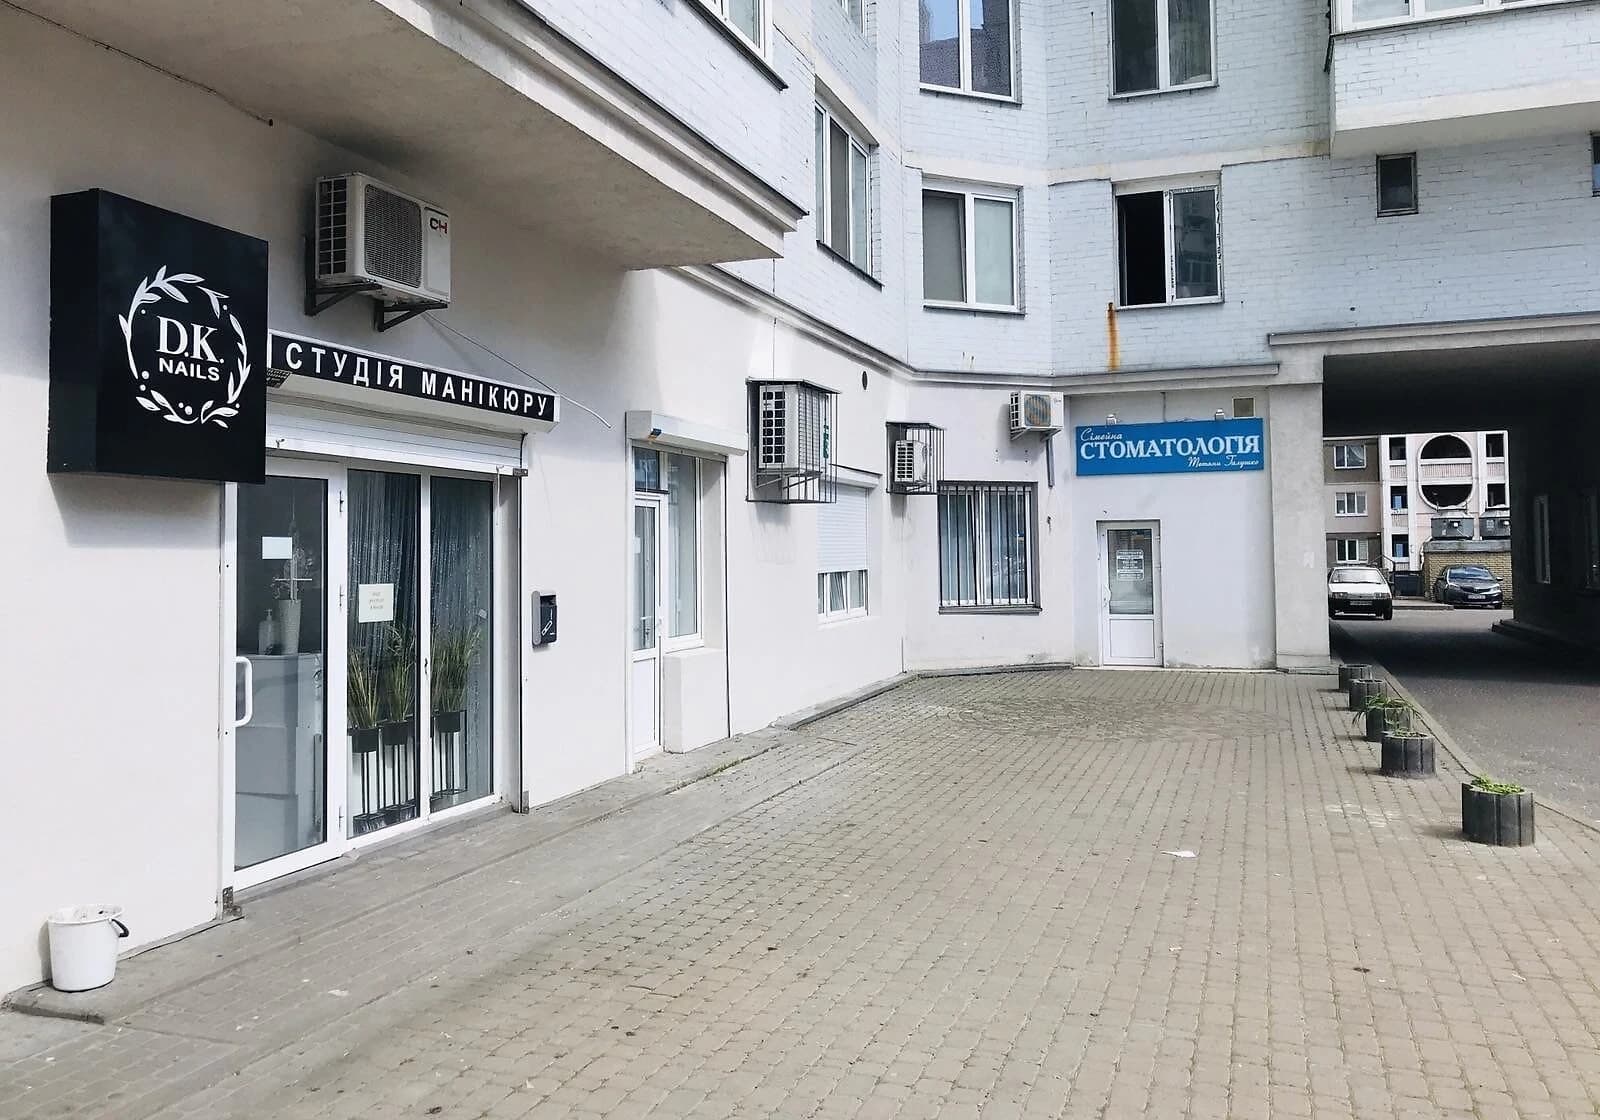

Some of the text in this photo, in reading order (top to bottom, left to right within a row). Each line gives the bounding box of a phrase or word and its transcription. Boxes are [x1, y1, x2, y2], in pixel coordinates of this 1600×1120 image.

[155, 315, 225, 364] D.K.
[159, 357, 220, 382] NAILS
[285, 342, 548, 417] СТУДІЯ МАНІКЮРУ
[1080, 427, 1123, 441] Сімейна
[1080, 435, 1260, 460] СТОМАТОЛОГІЯ
